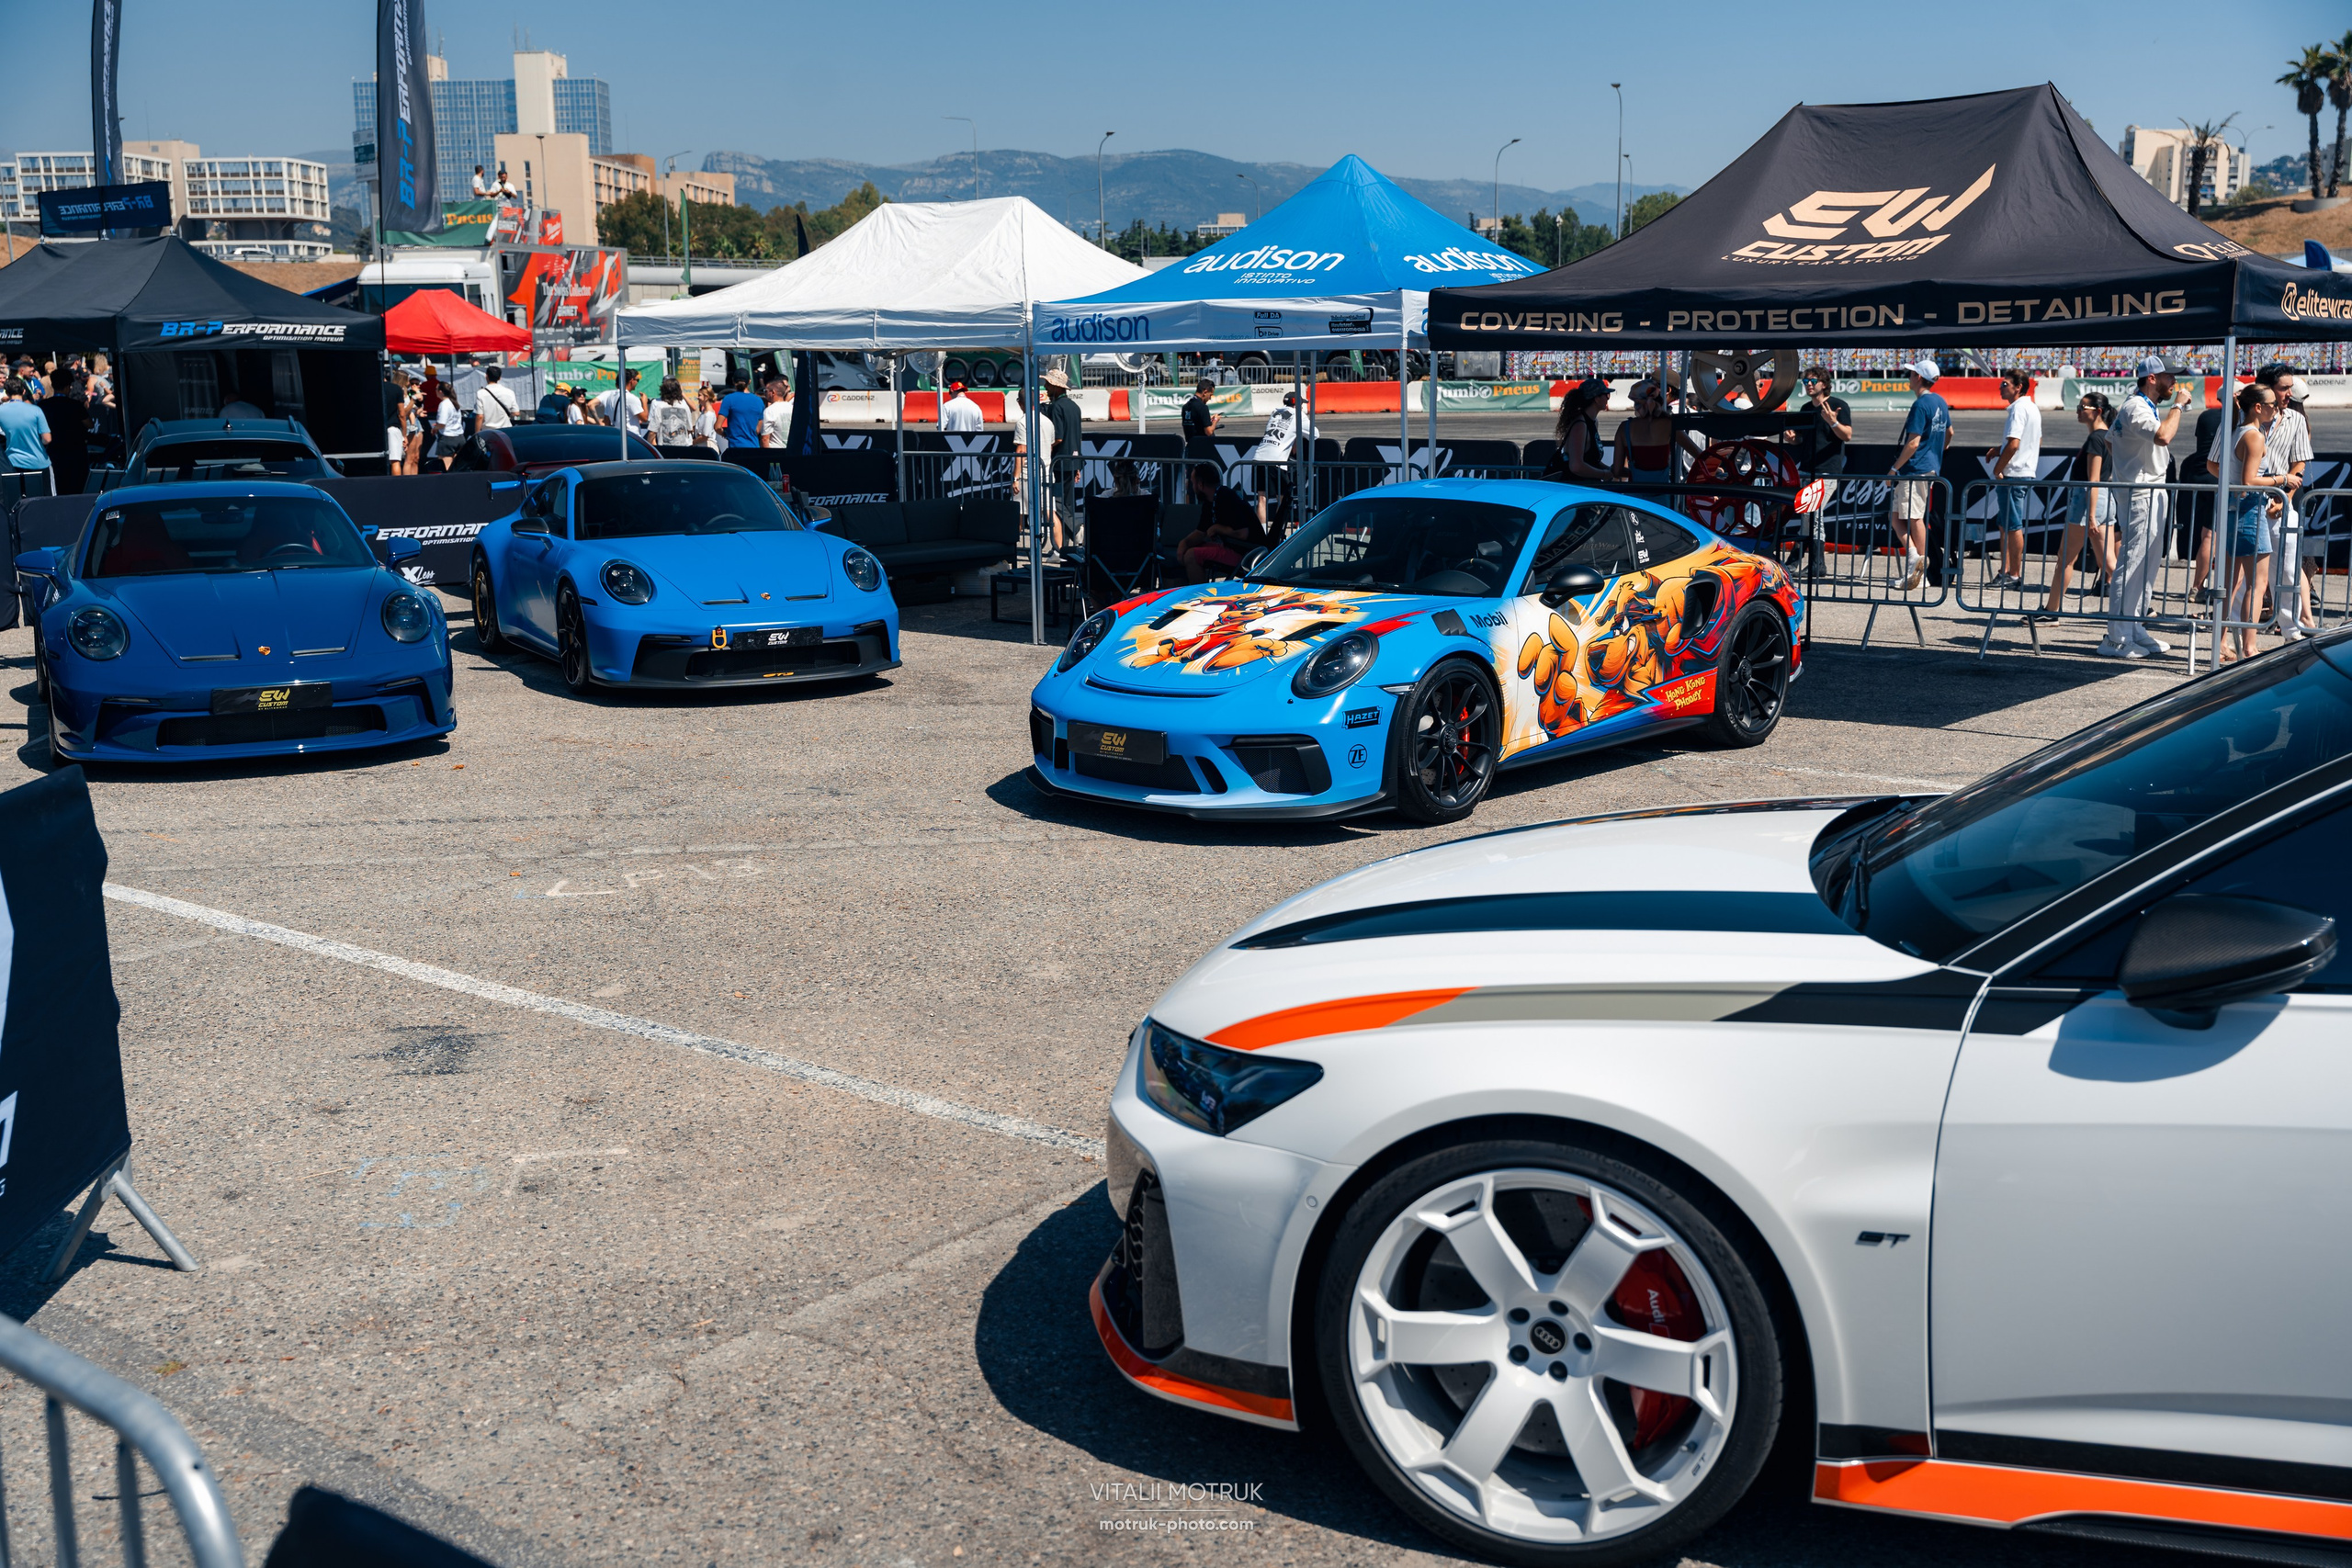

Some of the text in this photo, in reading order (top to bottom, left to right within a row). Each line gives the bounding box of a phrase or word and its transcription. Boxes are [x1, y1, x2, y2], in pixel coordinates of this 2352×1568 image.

[447, 213, 493, 226] Pneus
[1732, 233, 1951, 261] CUSTOM
[1183, 245, 1346, 274] audison
[1403, 247, 1533, 273] audison
[1721, 254, 1793, 265] LUXURY
[1833, 254, 1920, 265] STYLING
[1460, 311, 1623, 333] COVERING
[1668, 304, 1905, 332] PROTECTION
[1958, 289, 2186, 324] DETAILING
[1051, 313, 1149, 342] audison
[1493, 385, 1541, 397] Pneus
[1860, 380, 1910, 392] Pneus
[1468, 611, 1509, 628] Mobil
[1347, 712, 1379, 725] HAZET
[1100, 745, 1125, 753] CUSTOM
[1350, 749, 1366, 763] ZF
[1646, 1288, 1665, 1323] Audi
